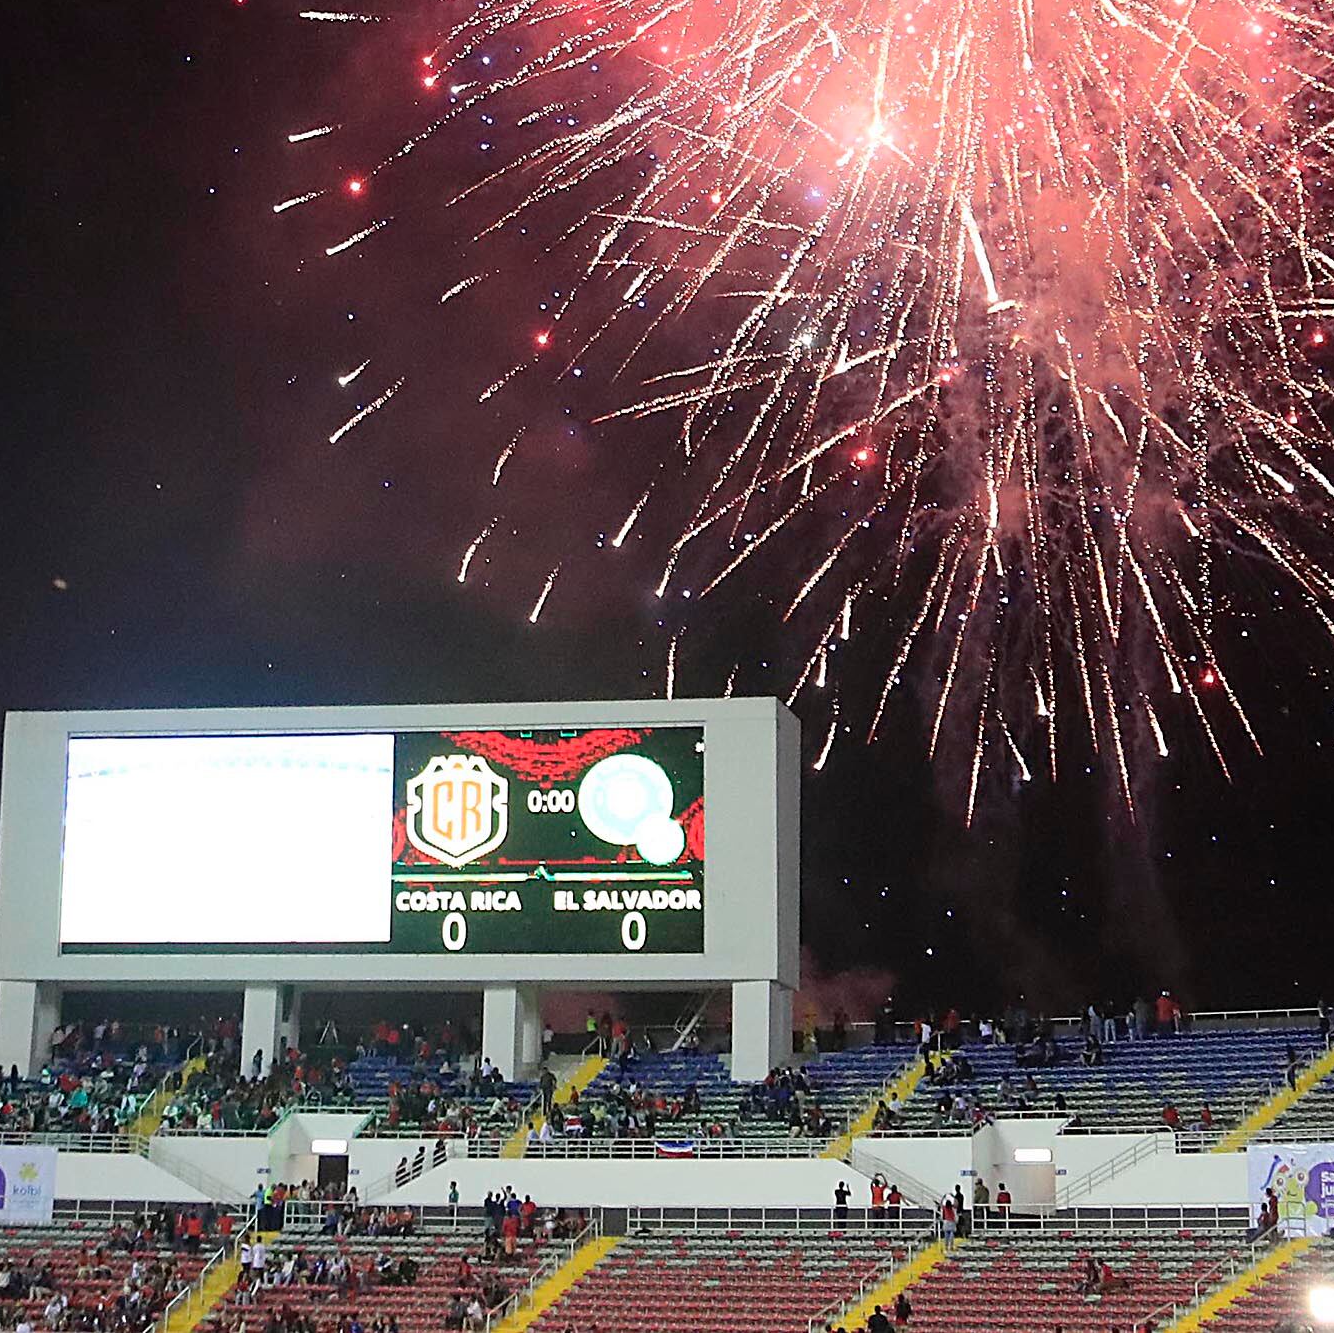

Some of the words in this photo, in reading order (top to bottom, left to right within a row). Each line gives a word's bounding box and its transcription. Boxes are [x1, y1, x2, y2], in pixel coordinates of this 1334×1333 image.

[527, 789, 576, 813] 0:00
[395, 891, 467, 911] COSTA
[470, 891, 523, 911] RICA
[553, 890, 579, 911] EL
[582, 889, 702, 911] SALVADOR
[442, 912, 467, 951] 0
[621, 911, 646, 950] 0
